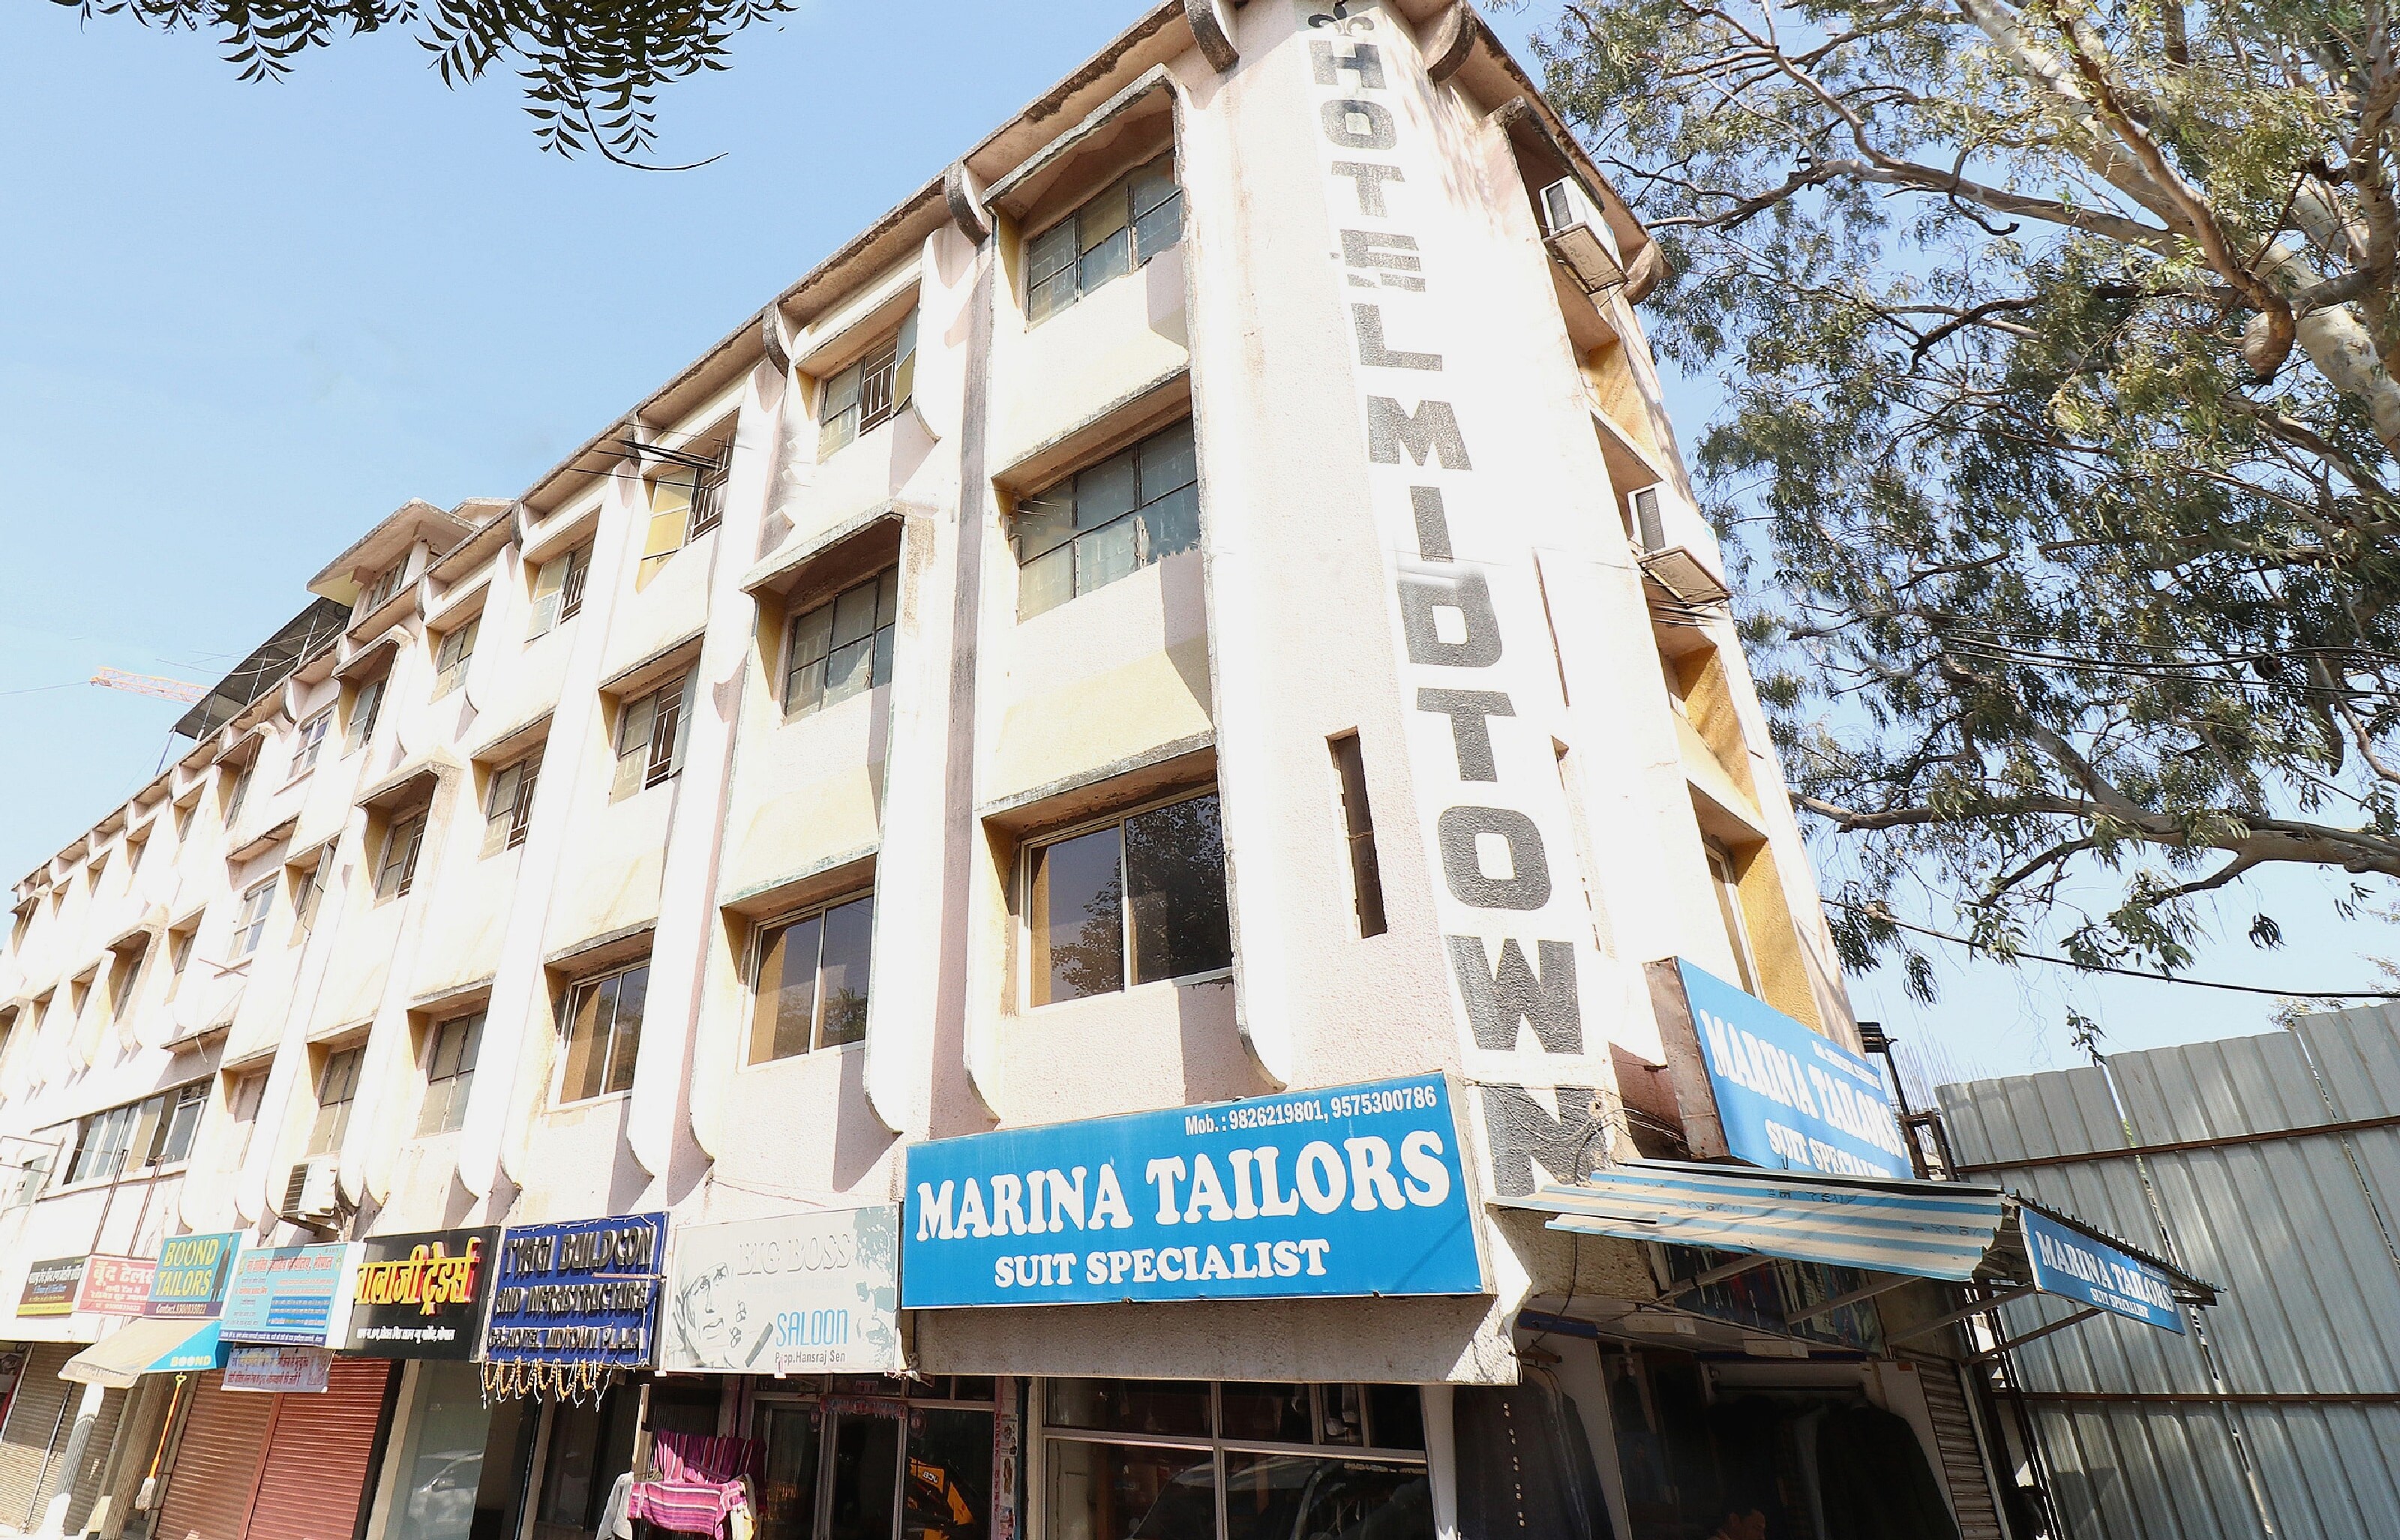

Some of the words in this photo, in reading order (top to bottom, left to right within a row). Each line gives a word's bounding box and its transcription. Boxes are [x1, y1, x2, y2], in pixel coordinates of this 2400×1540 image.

[1309, 40, 1443, 372] HOTEL
[1367, 394, 1608, 1198] MIDTOWN
[1700, 1008, 1820, 1119] MARINA
[1808, 1063, 1903, 1159] TAILORS
[1228, 1099, 1329, 1131] 9826219801,
[1330, 1085, 1438, 1118] 9575300786
[1765, 1119, 1810, 1166] SUIT
[916, 1164, 1134, 1242] MARINA
[1145, 1131, 1450, 1225] TAILORS
[163, 1238, 219, 1267] BOOND
[557, 1227, 655, 1271] BUILDCON
[994, 1252, 1078, 1288] SUIT
[1086, 1239, 1330, 1285] SPECIALIST
[2035, 1230, 2115, 1290] MARINA
[2110, 1262, 2174, 1313] TAILORS
[155, 1269, 212, 1296] TAILORS
[170, 1354, 212, 1368] BOOND
[829, 1350, 845, 1362] Sen
